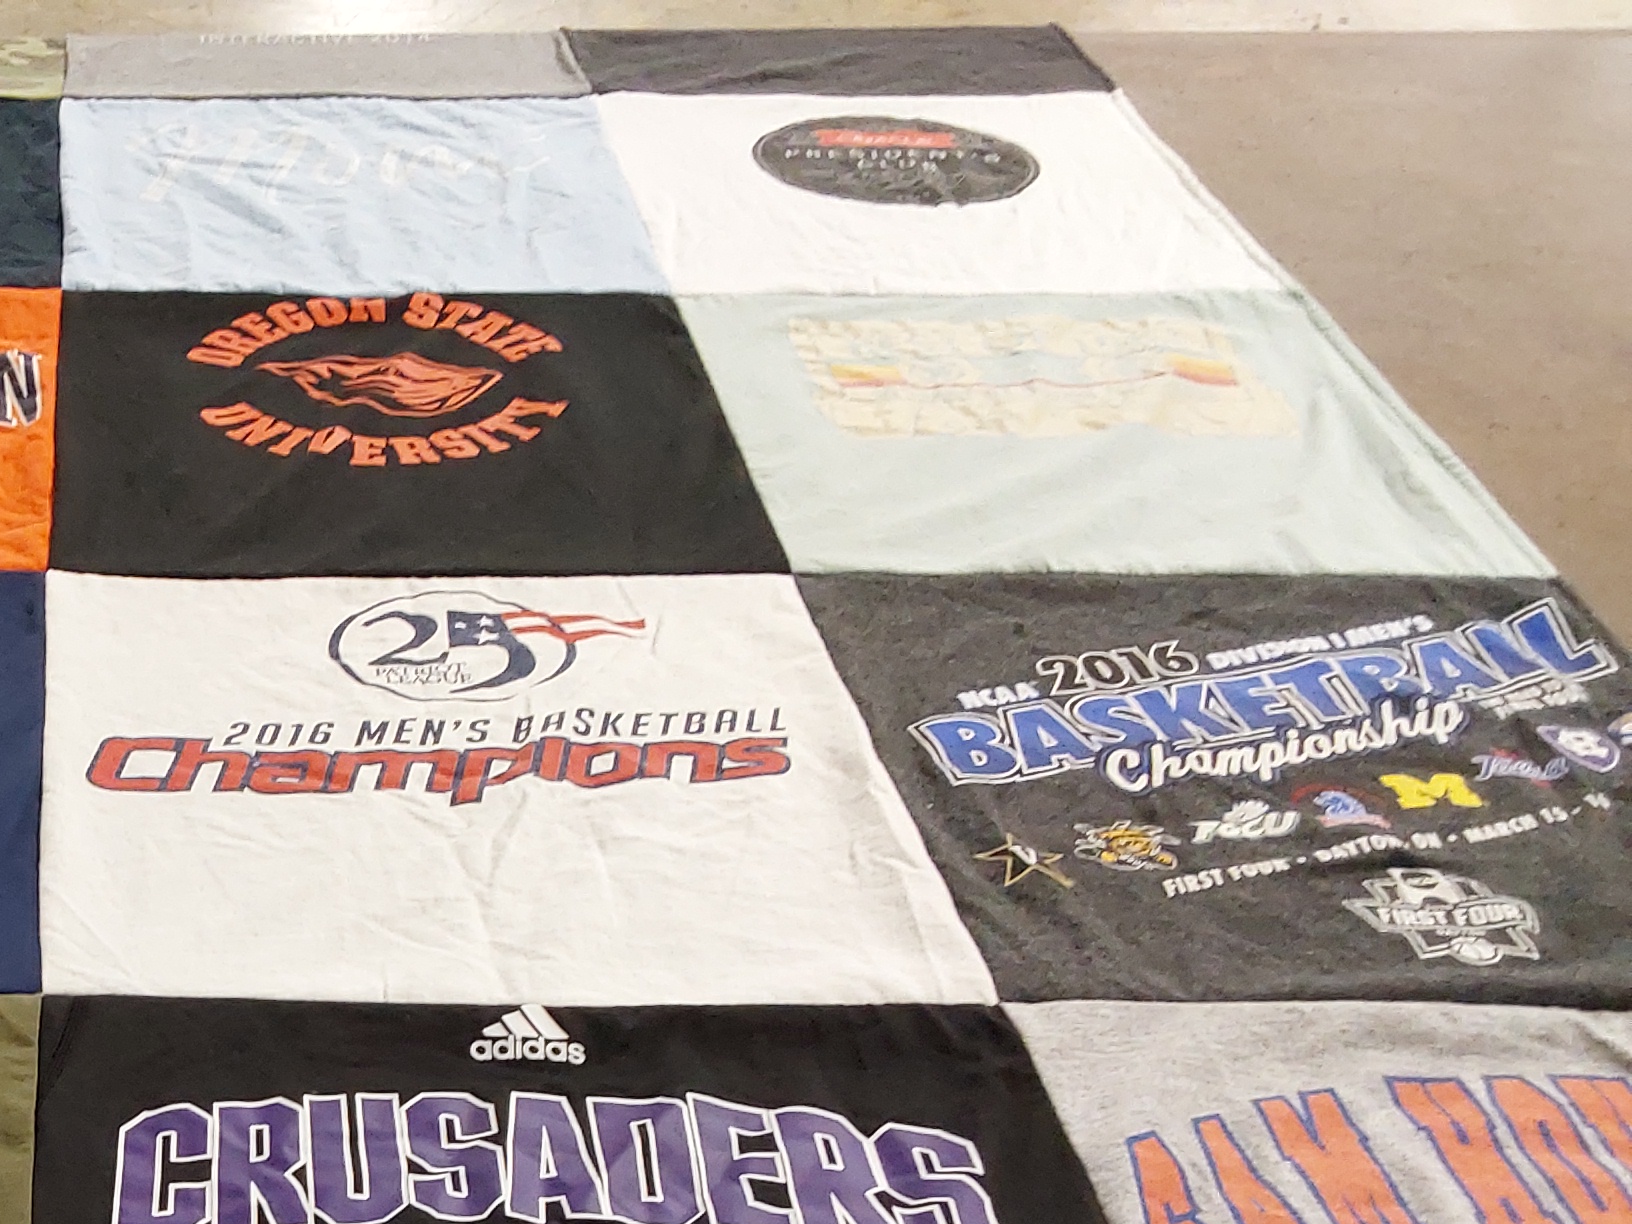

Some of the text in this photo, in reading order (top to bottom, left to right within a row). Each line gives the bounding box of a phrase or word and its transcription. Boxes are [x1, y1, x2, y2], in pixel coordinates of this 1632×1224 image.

[186, 292, 563, 367] OREGON STATE
[200, 396, 568, 467] UNIVERSITY
[907, 597, 1619, 786] BASKETBALL
[956, 680, 1039, 709] NCAA
[1035, 640, 1200, 697] 2016
[221, 706, 788, 747] 2016 MEN'S BASKETBALL
[1103, 697, 1466, 794] Championship
[85, 735, 792, 807] Champions
[1162, 870, 1226, 899] FIRST
[1229, 857, 1291, 881] FOUR
[1462, 813, 1540, 844] MARCH
[1452, 903, 1525, 926] FOUR
[469, 1029, 587, 1065] adidas
